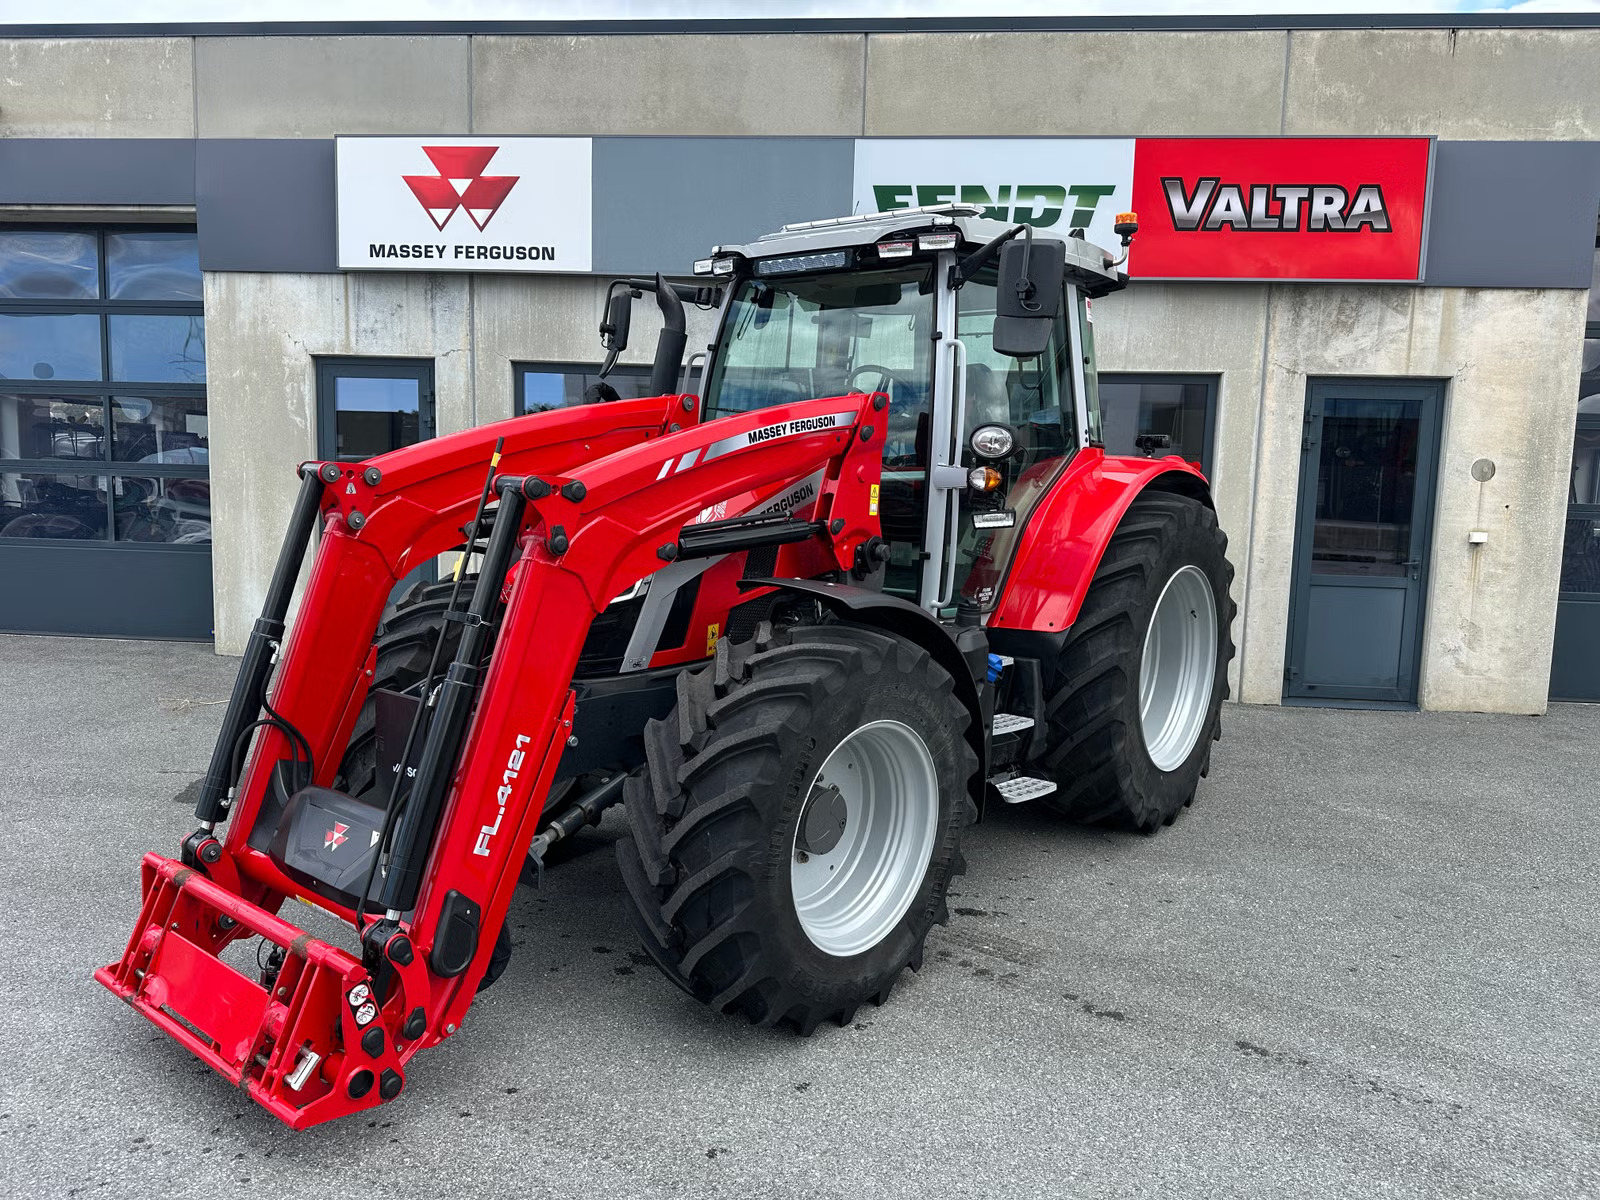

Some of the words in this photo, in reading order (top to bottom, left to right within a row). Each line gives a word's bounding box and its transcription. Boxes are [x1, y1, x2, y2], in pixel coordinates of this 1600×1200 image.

[1160, 177, 1392, 232] VALTRA
[369, 244, 447, 259] MASSEY
[454, 245, 555, 261] FERGUSON
[748, 423, 787, 444] MASSEY
[790, 415, 836, 433] FERGUSON
[472, 734, 531, 857] FL.4121
